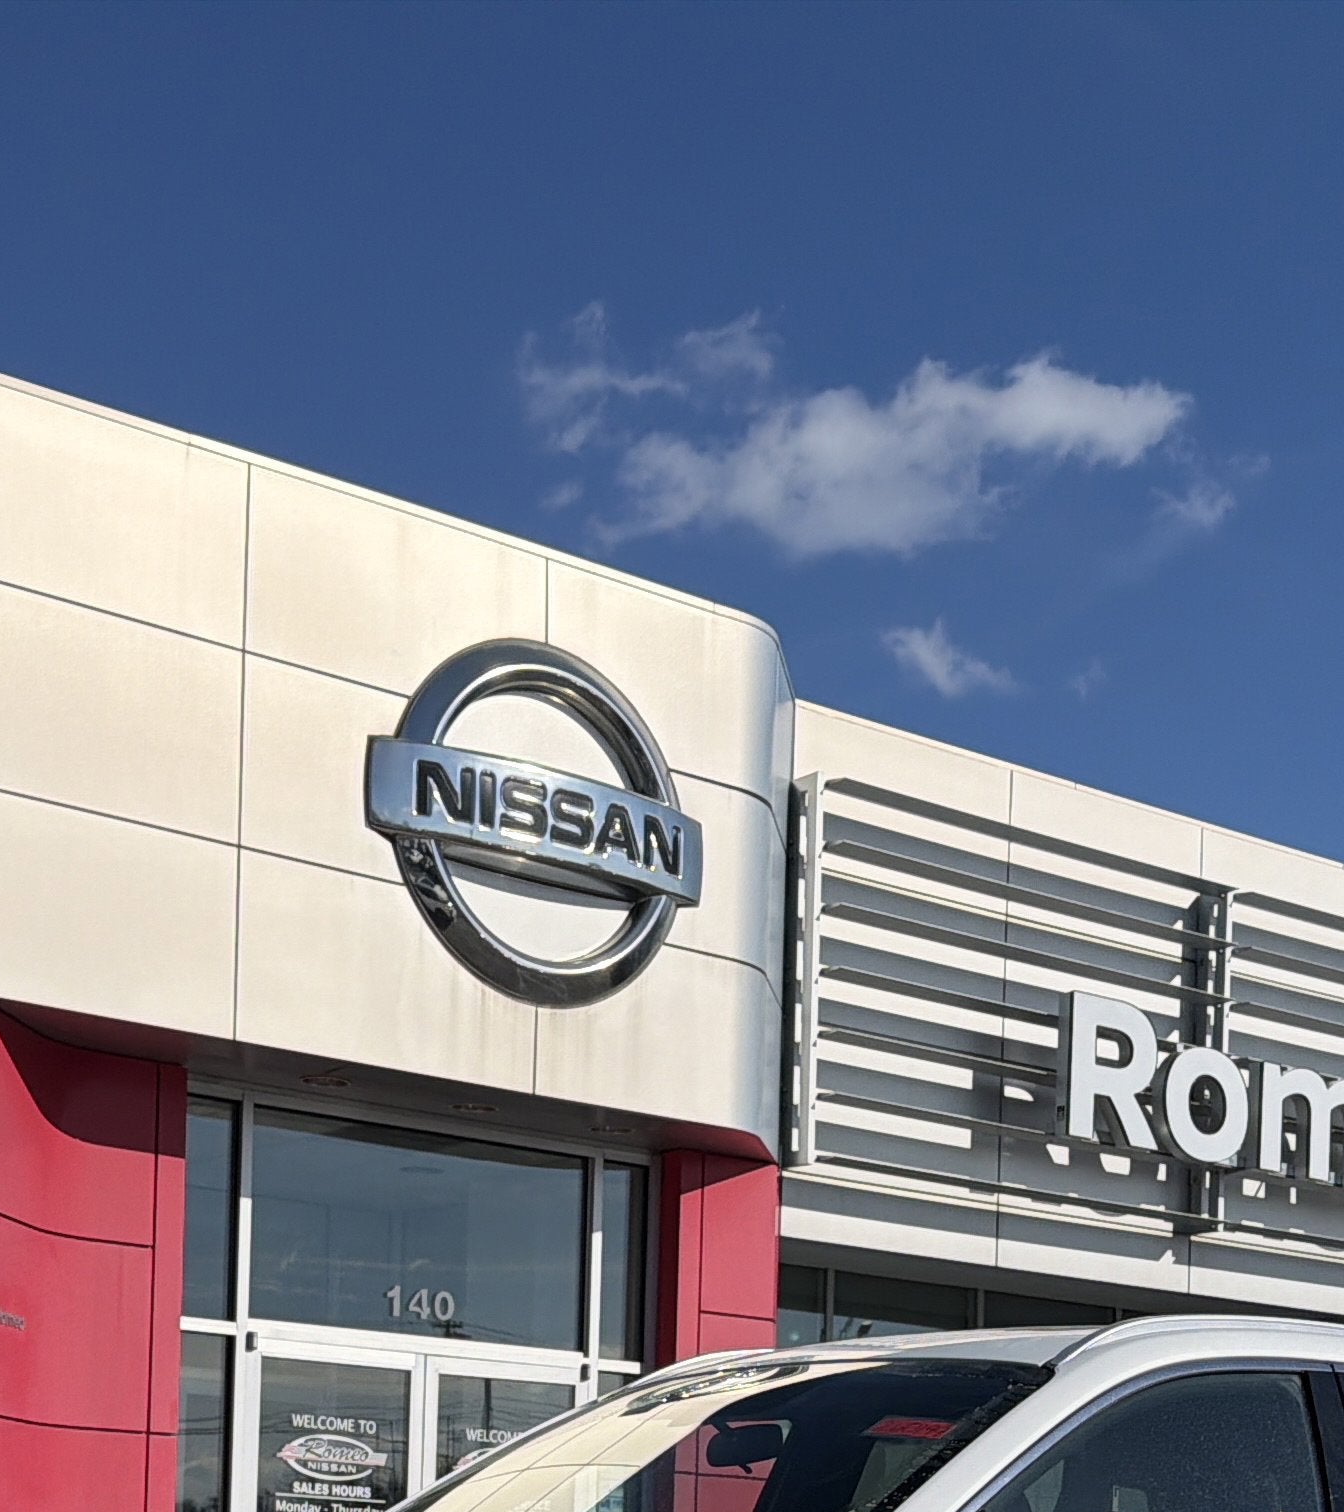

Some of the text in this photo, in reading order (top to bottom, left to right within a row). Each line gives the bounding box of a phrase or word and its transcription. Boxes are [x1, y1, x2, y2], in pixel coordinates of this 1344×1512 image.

[413, 757, 684, 880] NISSAN
[386, 1284, 455, 1321] 140
[292, 1413, 377, 1435] WELCOME TO
[297, 1437, 370, 1462] Romeo
[307, 1461, 357, 1474] NISSAN
[292, 1481, 372, 1499] SALES HOURS
